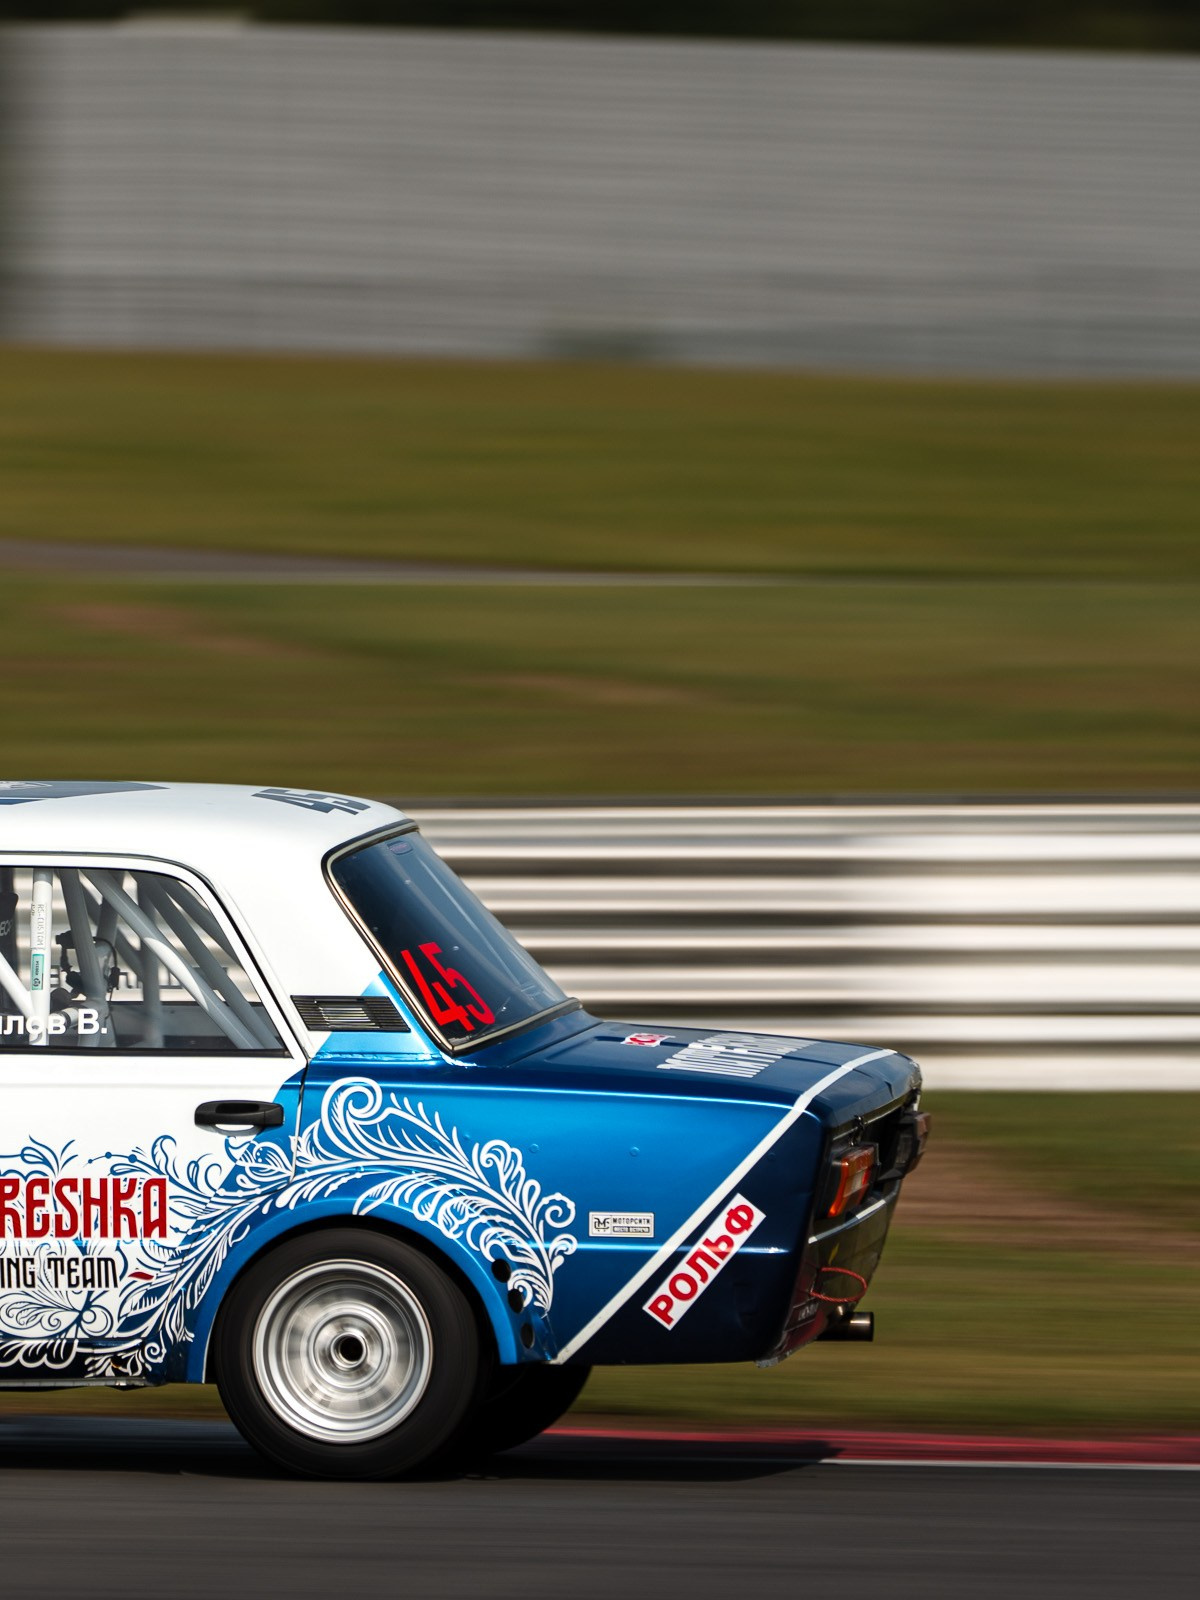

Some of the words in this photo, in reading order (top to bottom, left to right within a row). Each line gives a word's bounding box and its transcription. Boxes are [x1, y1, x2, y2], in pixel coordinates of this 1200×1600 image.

[401, 941, 496, 1032] 45
[77, 1008, 108, 1035] В.
[48, 1257, 120, 1289] TEAM
[647, 1203, 755, 1325] РОЛЬФ
